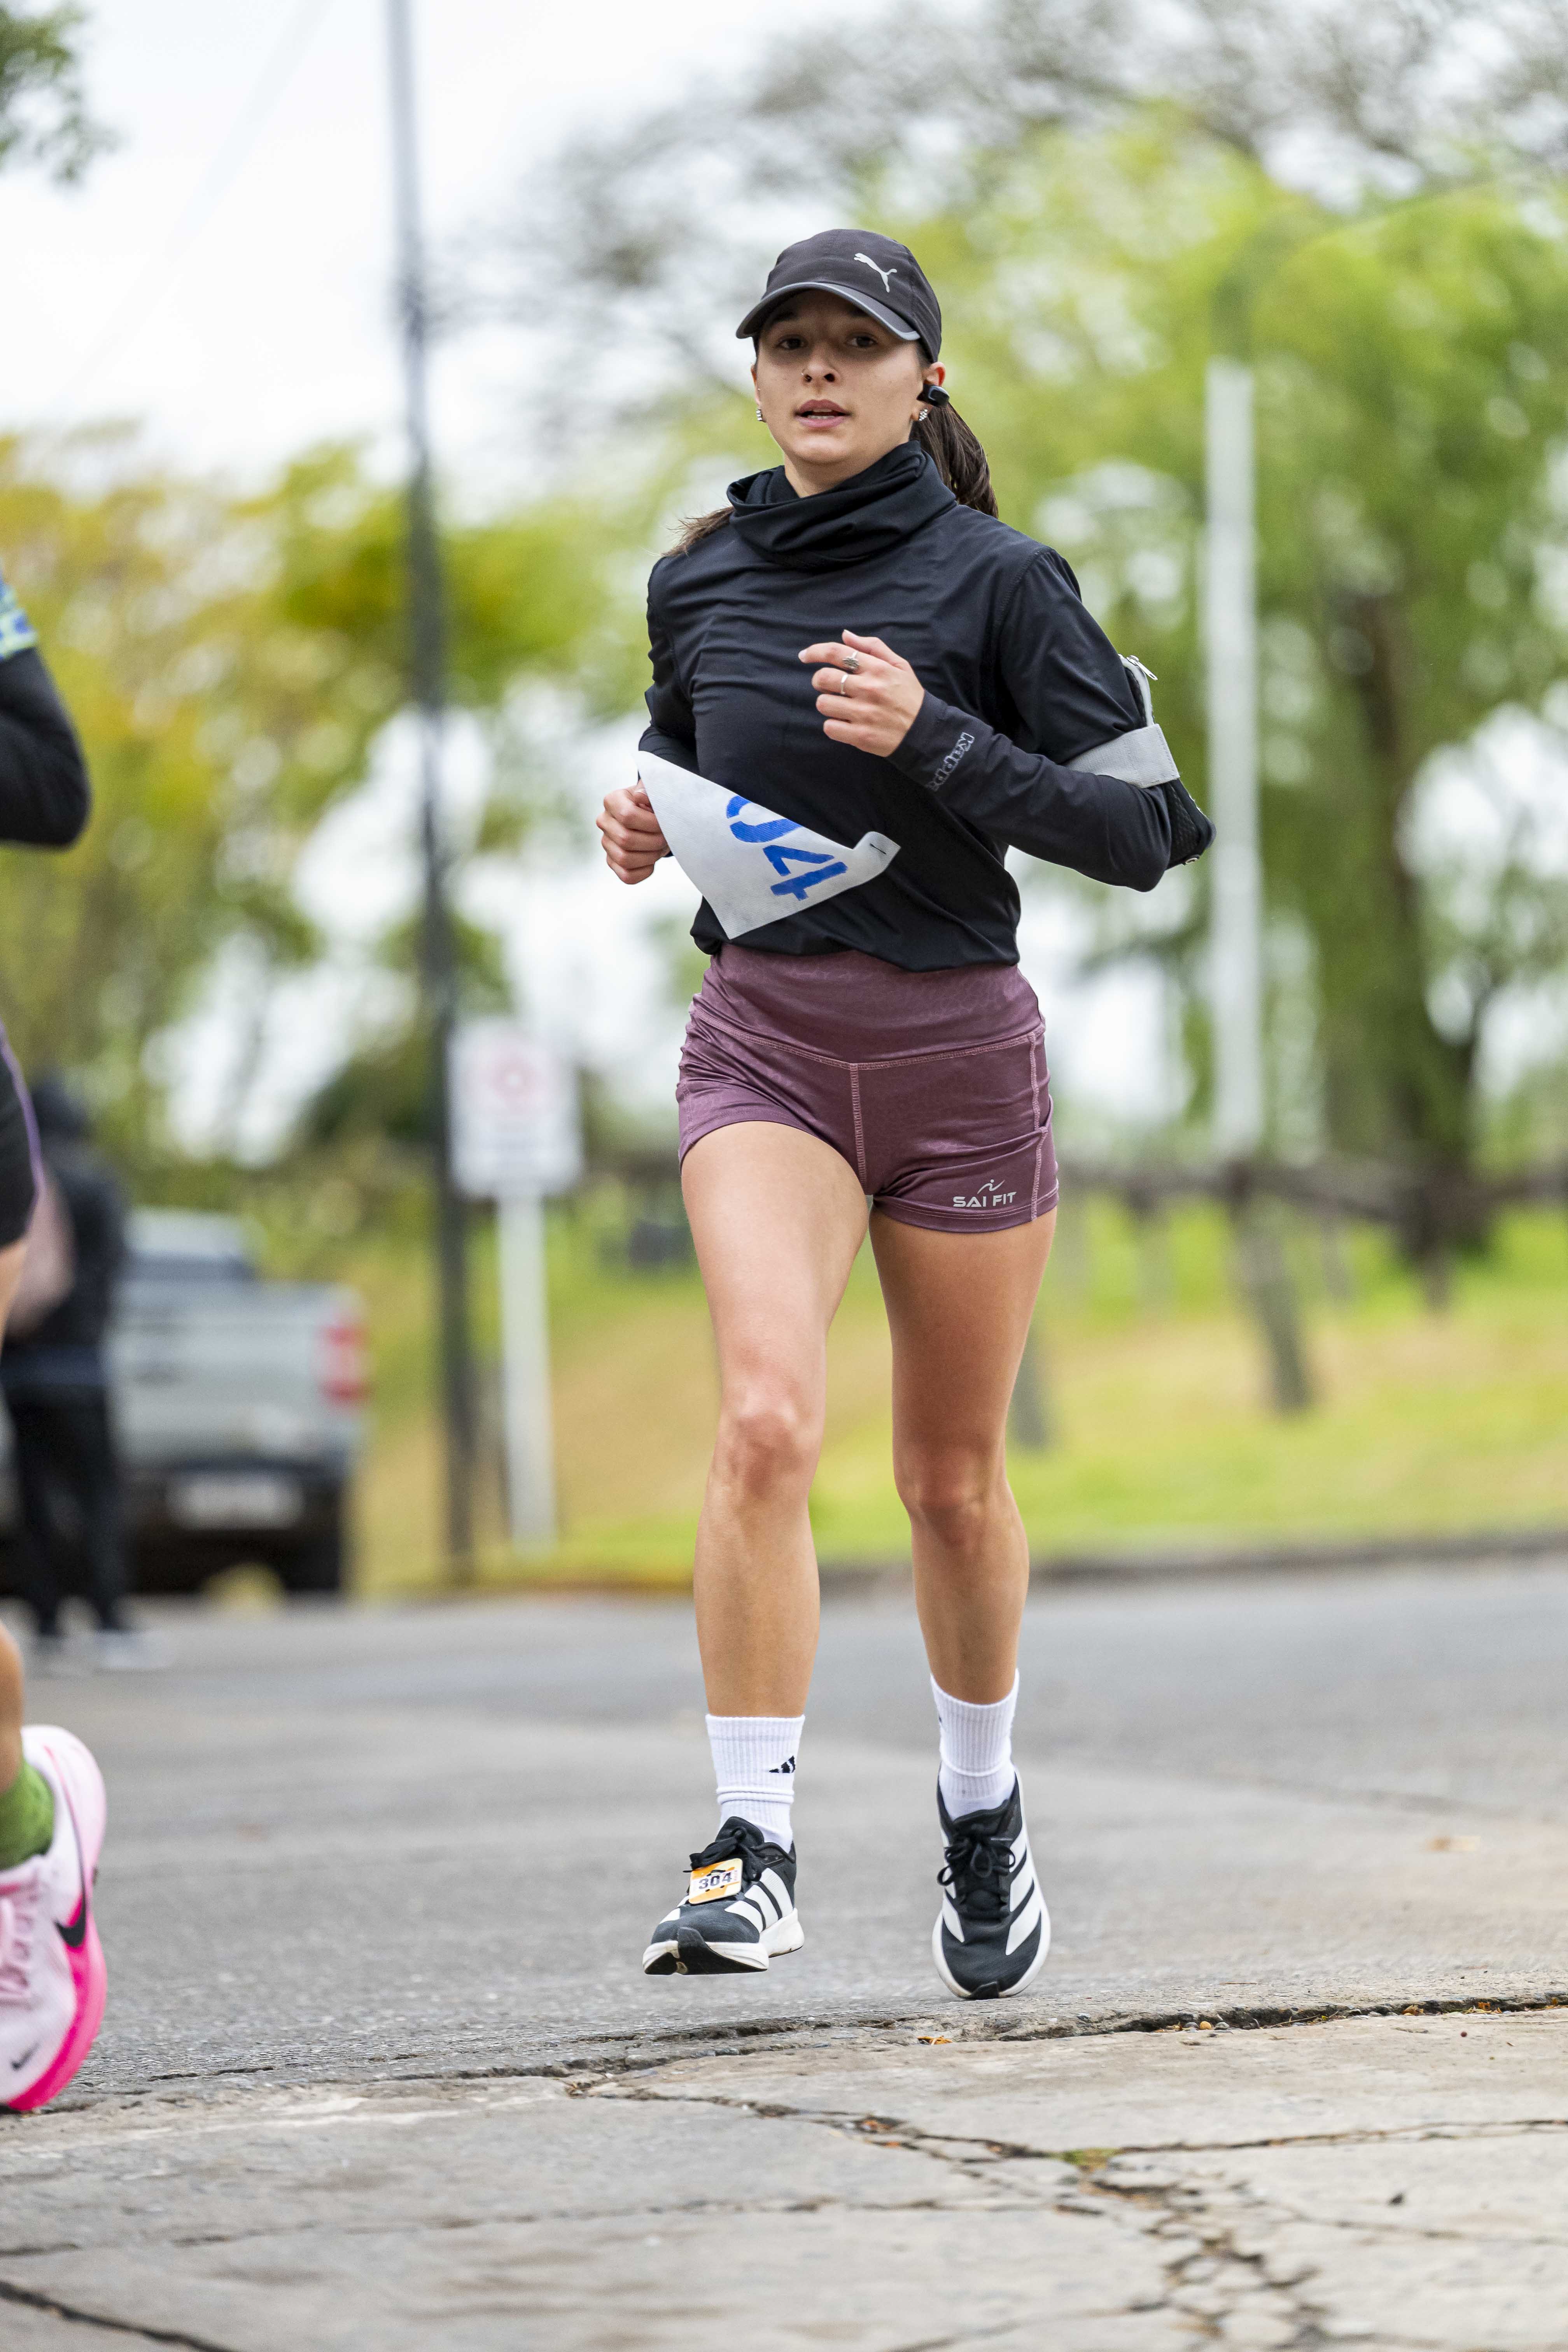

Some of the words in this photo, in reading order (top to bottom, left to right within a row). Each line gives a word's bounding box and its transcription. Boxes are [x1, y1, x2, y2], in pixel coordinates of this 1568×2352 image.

[953, 1196, 987, 1207] SAI
[992, 1192, 1017, 1206] FIT
[698, 1872, 732, 1889] 304
